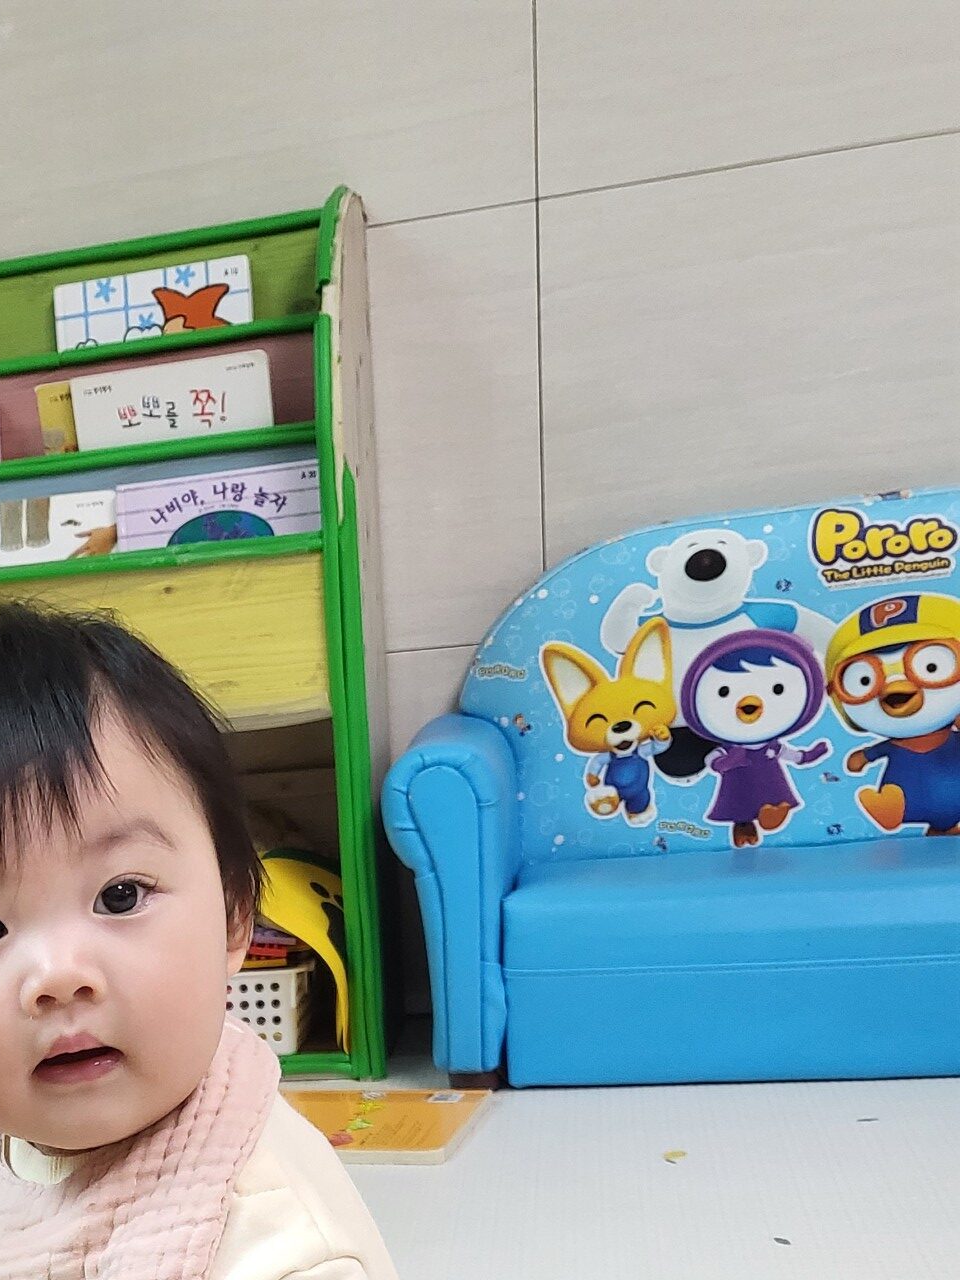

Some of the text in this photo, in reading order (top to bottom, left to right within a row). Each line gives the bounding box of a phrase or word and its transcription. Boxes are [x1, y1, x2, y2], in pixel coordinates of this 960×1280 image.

[117, 389, 228, 429] 뽀뽀를 쪽!
[212, 481, 248, 503] 나랑
[253, 486, 289, 513] 놀자
[812, 509, 957, 565] Pororo
[822, 569, 850, 582] The
[850, 564, 893, 580] Little
[892, 557, 951, 574] Penguin
[869, 600, 908, 628] P
